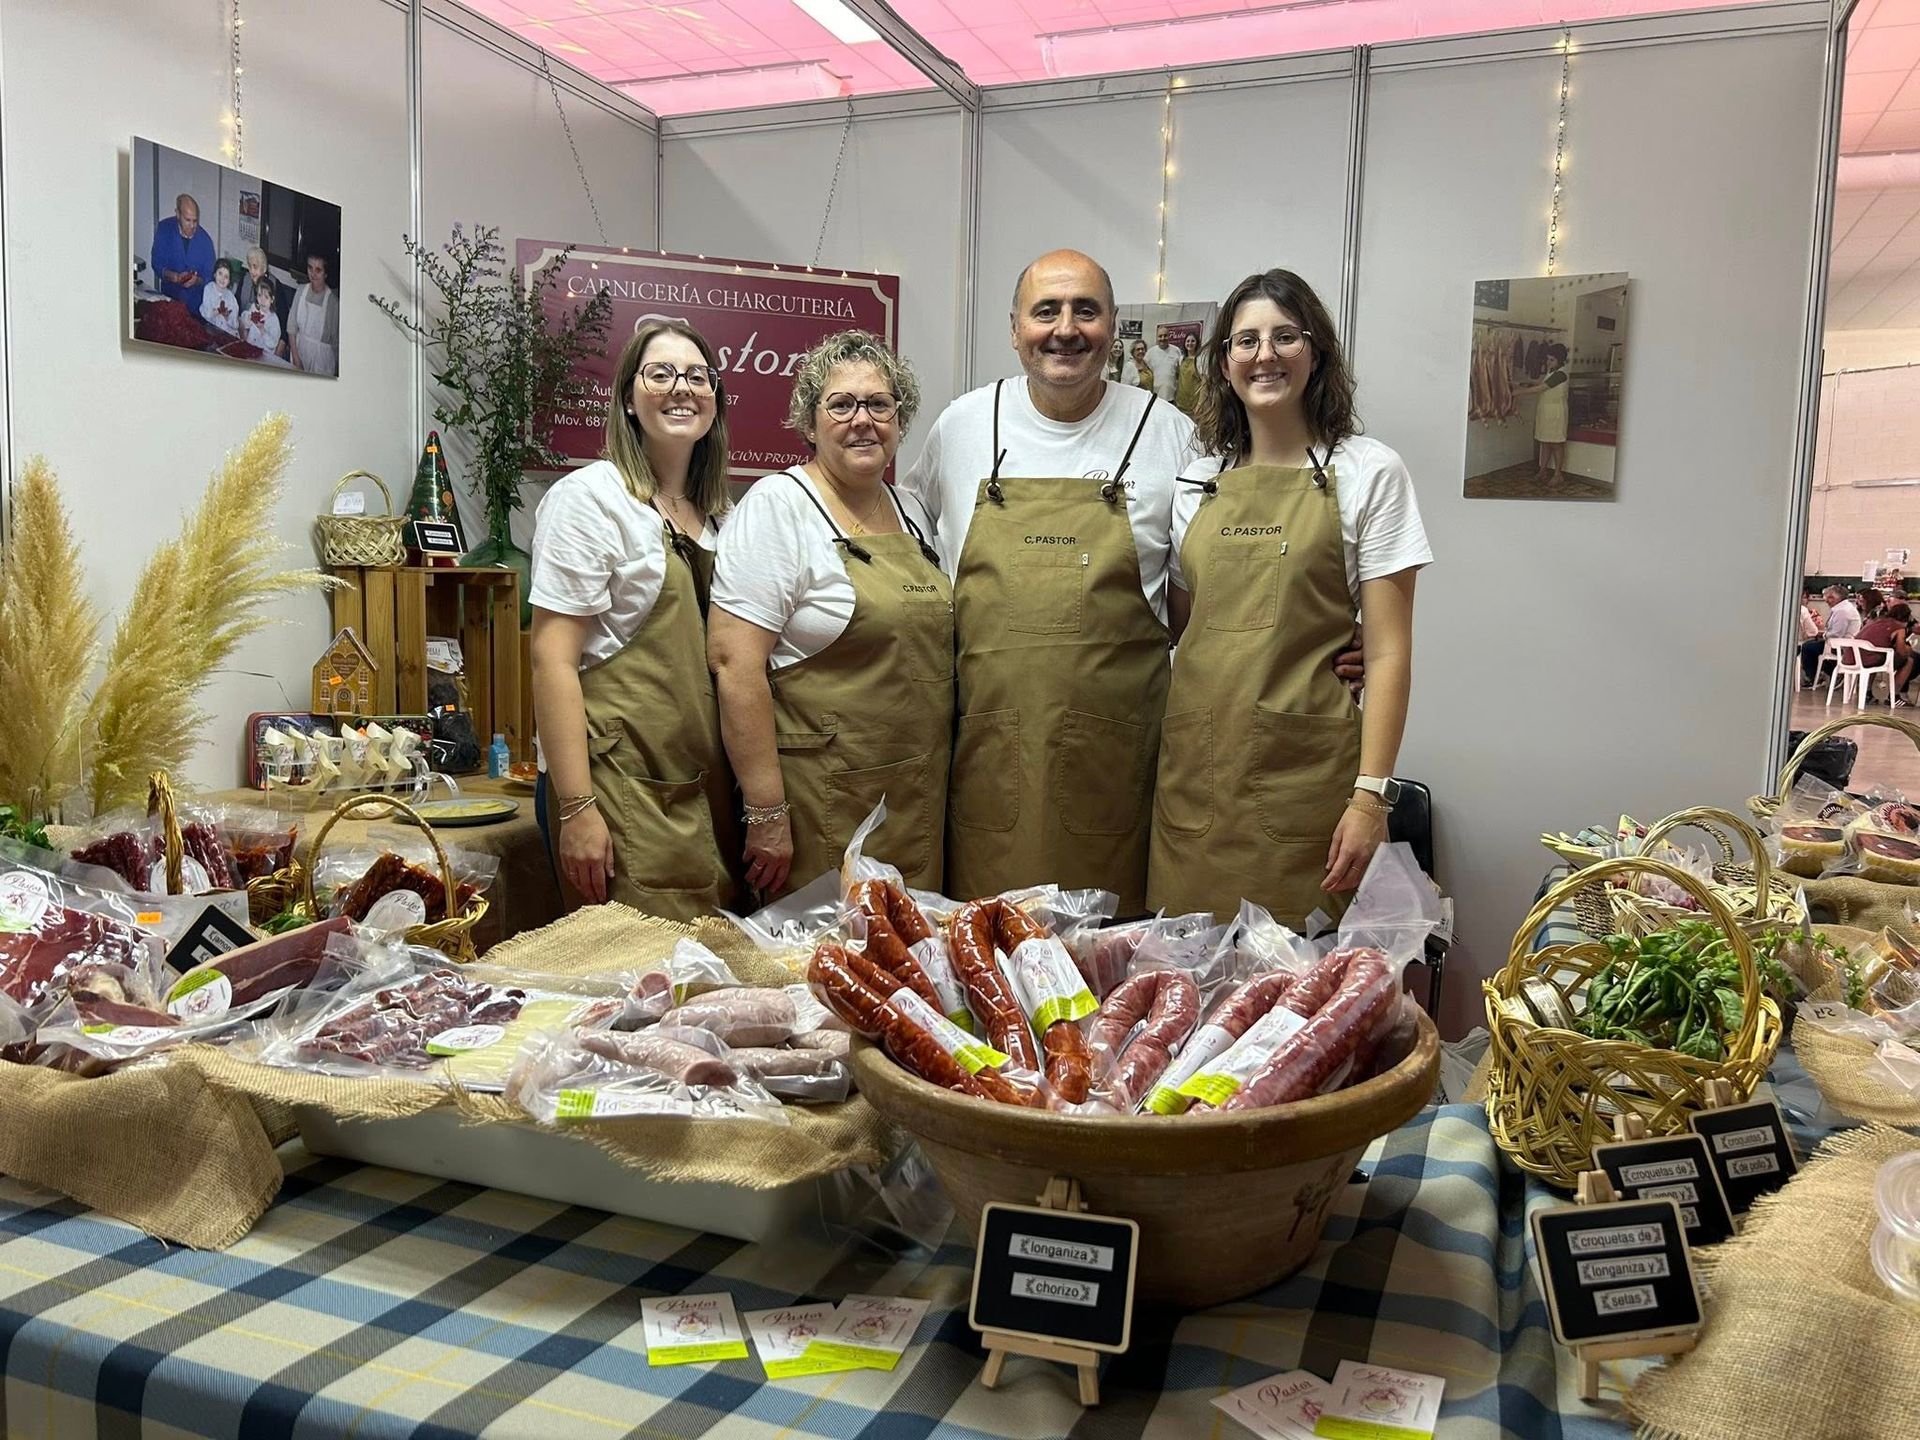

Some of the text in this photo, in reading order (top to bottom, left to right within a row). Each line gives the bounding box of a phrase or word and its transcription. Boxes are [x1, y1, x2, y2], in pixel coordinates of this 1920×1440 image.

[567, 275, 856, 318] CARNICERÍA CHARCUTERÍA
[554, 413, 609, 427] Mov. 687
[764, 452, 809, 465] PROPIA
[1631, 1164, 1688, 1180] croquetas de
[1580, 1229, 1652, 1249] croquetas de
[1031, 1241, 1088, 1261] longaniza
[1591, 1262, 1655, 1278] longaniza y
[1035, 1281, 1079, 1298] chorizo
[1611, 1292, 1642, 1307] setas
[762, 1310, 823, 1325] Pastor
[1257, 1381, 1313, 1407] Pastor
